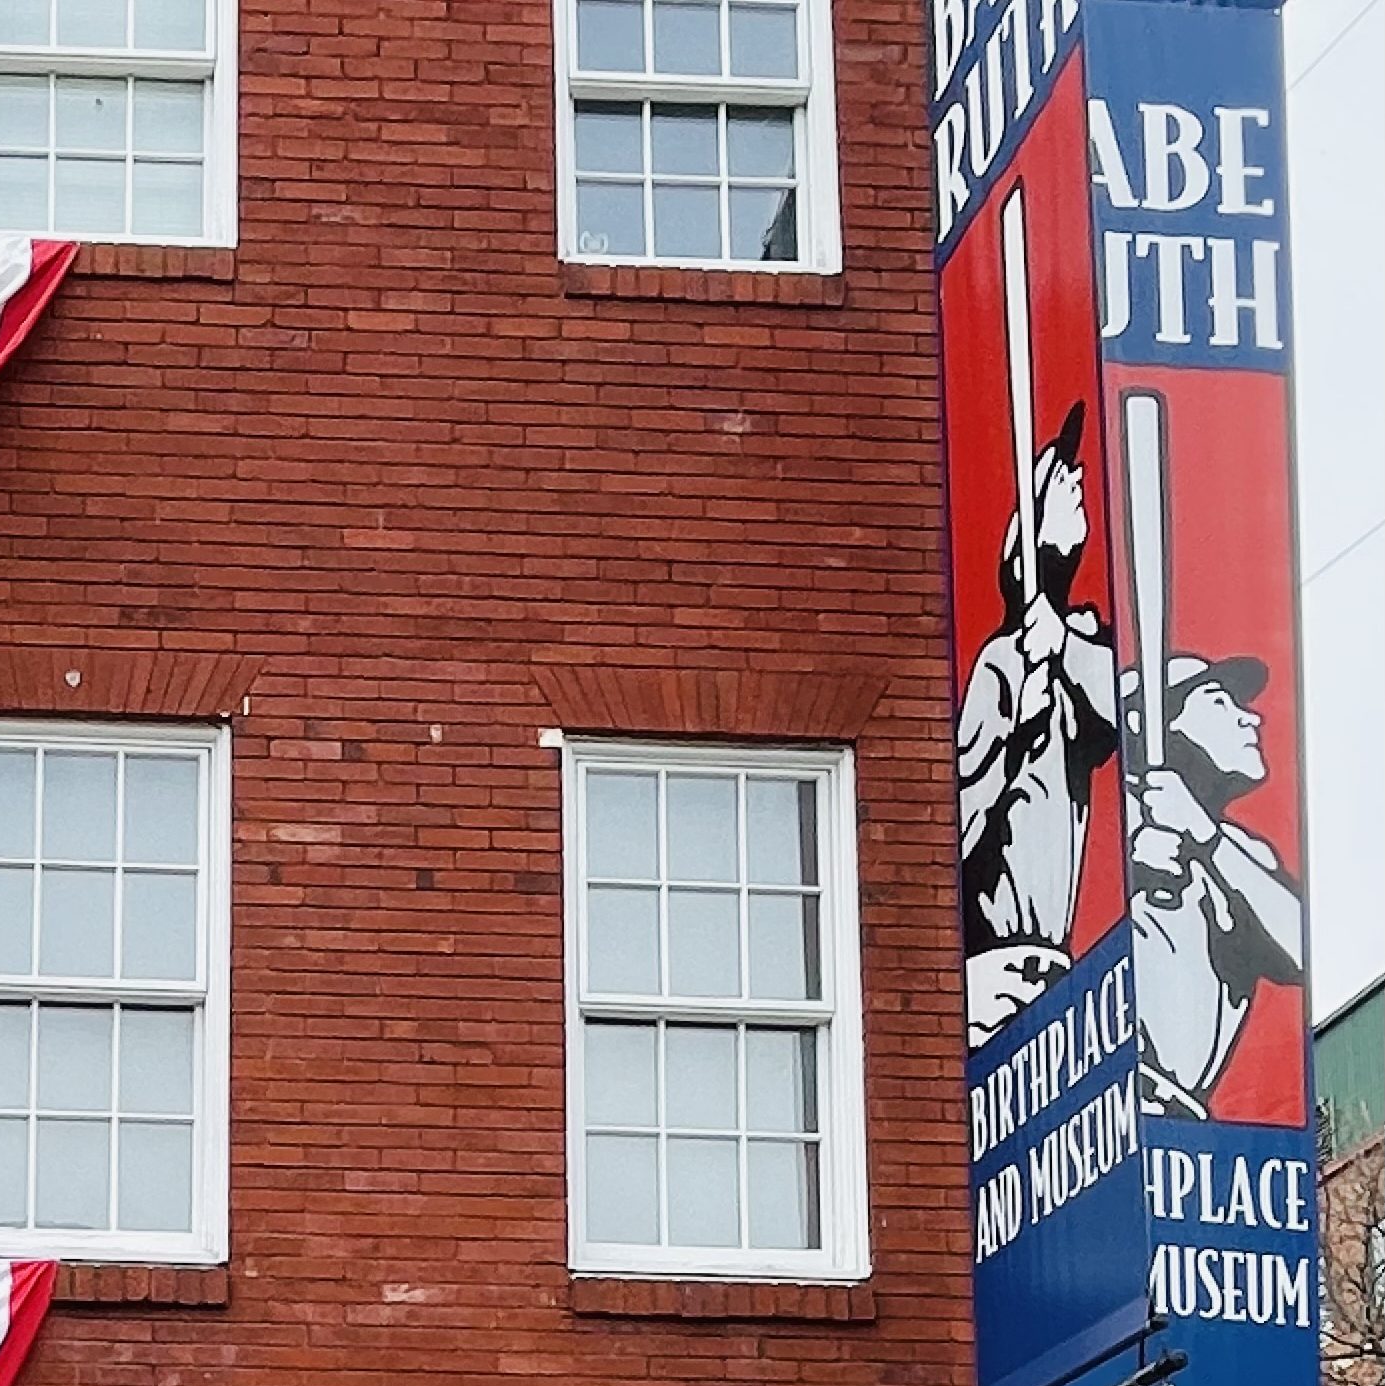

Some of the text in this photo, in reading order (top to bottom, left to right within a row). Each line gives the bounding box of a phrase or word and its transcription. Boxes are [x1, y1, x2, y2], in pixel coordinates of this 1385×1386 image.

[970, 956, 1135, 1163] BIRTHPLACE
[976, 1069, 1138, 1264] AND MUSEUM
[1149, 1244, 1310, 1328] MUSEUM
